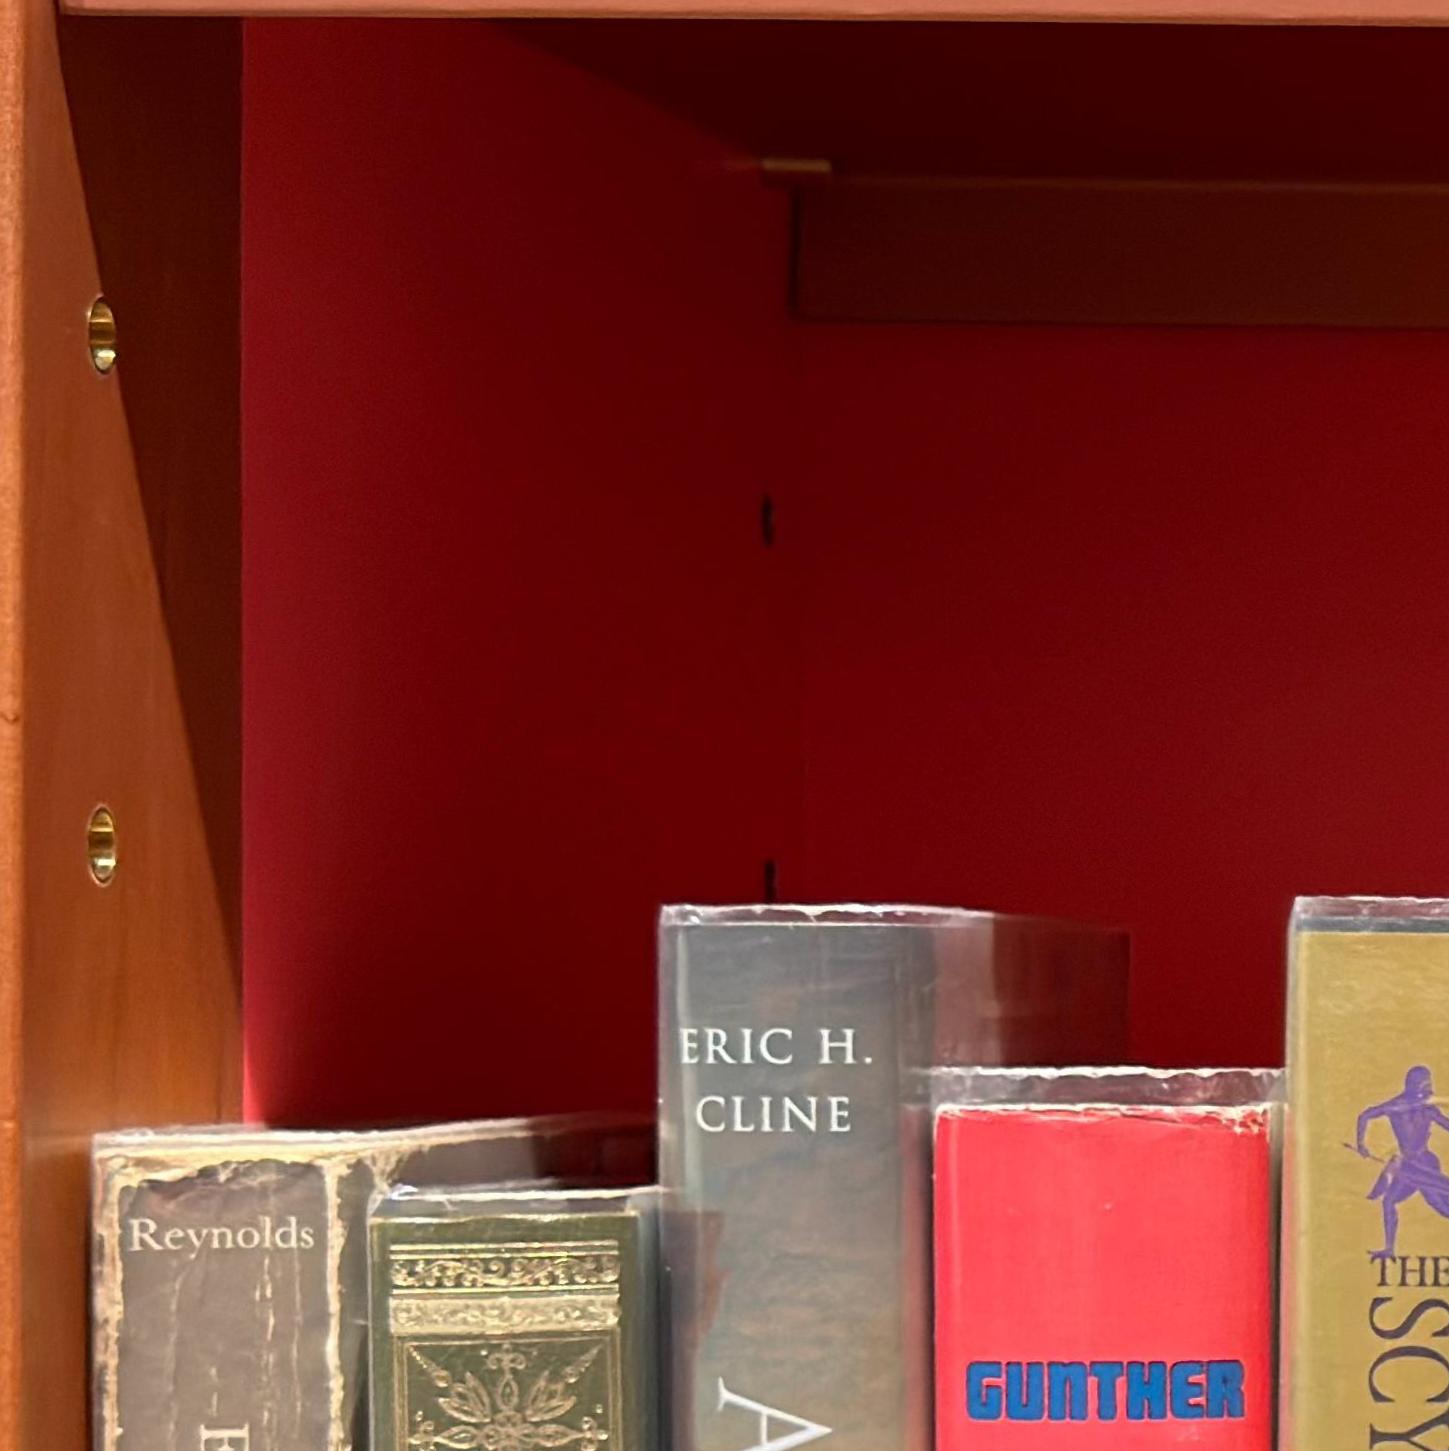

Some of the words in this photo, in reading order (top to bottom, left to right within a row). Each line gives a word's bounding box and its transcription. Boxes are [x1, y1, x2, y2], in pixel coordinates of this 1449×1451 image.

[680, 1027, 794, 1066] ERIC
[819, 1028, 874, 1065] H.
[695, 1095, 852, 1134] CLINE
[129, 1217, 315, 1257] Reynolds
[965, 1359, 1246, 1422] GUNTHER
